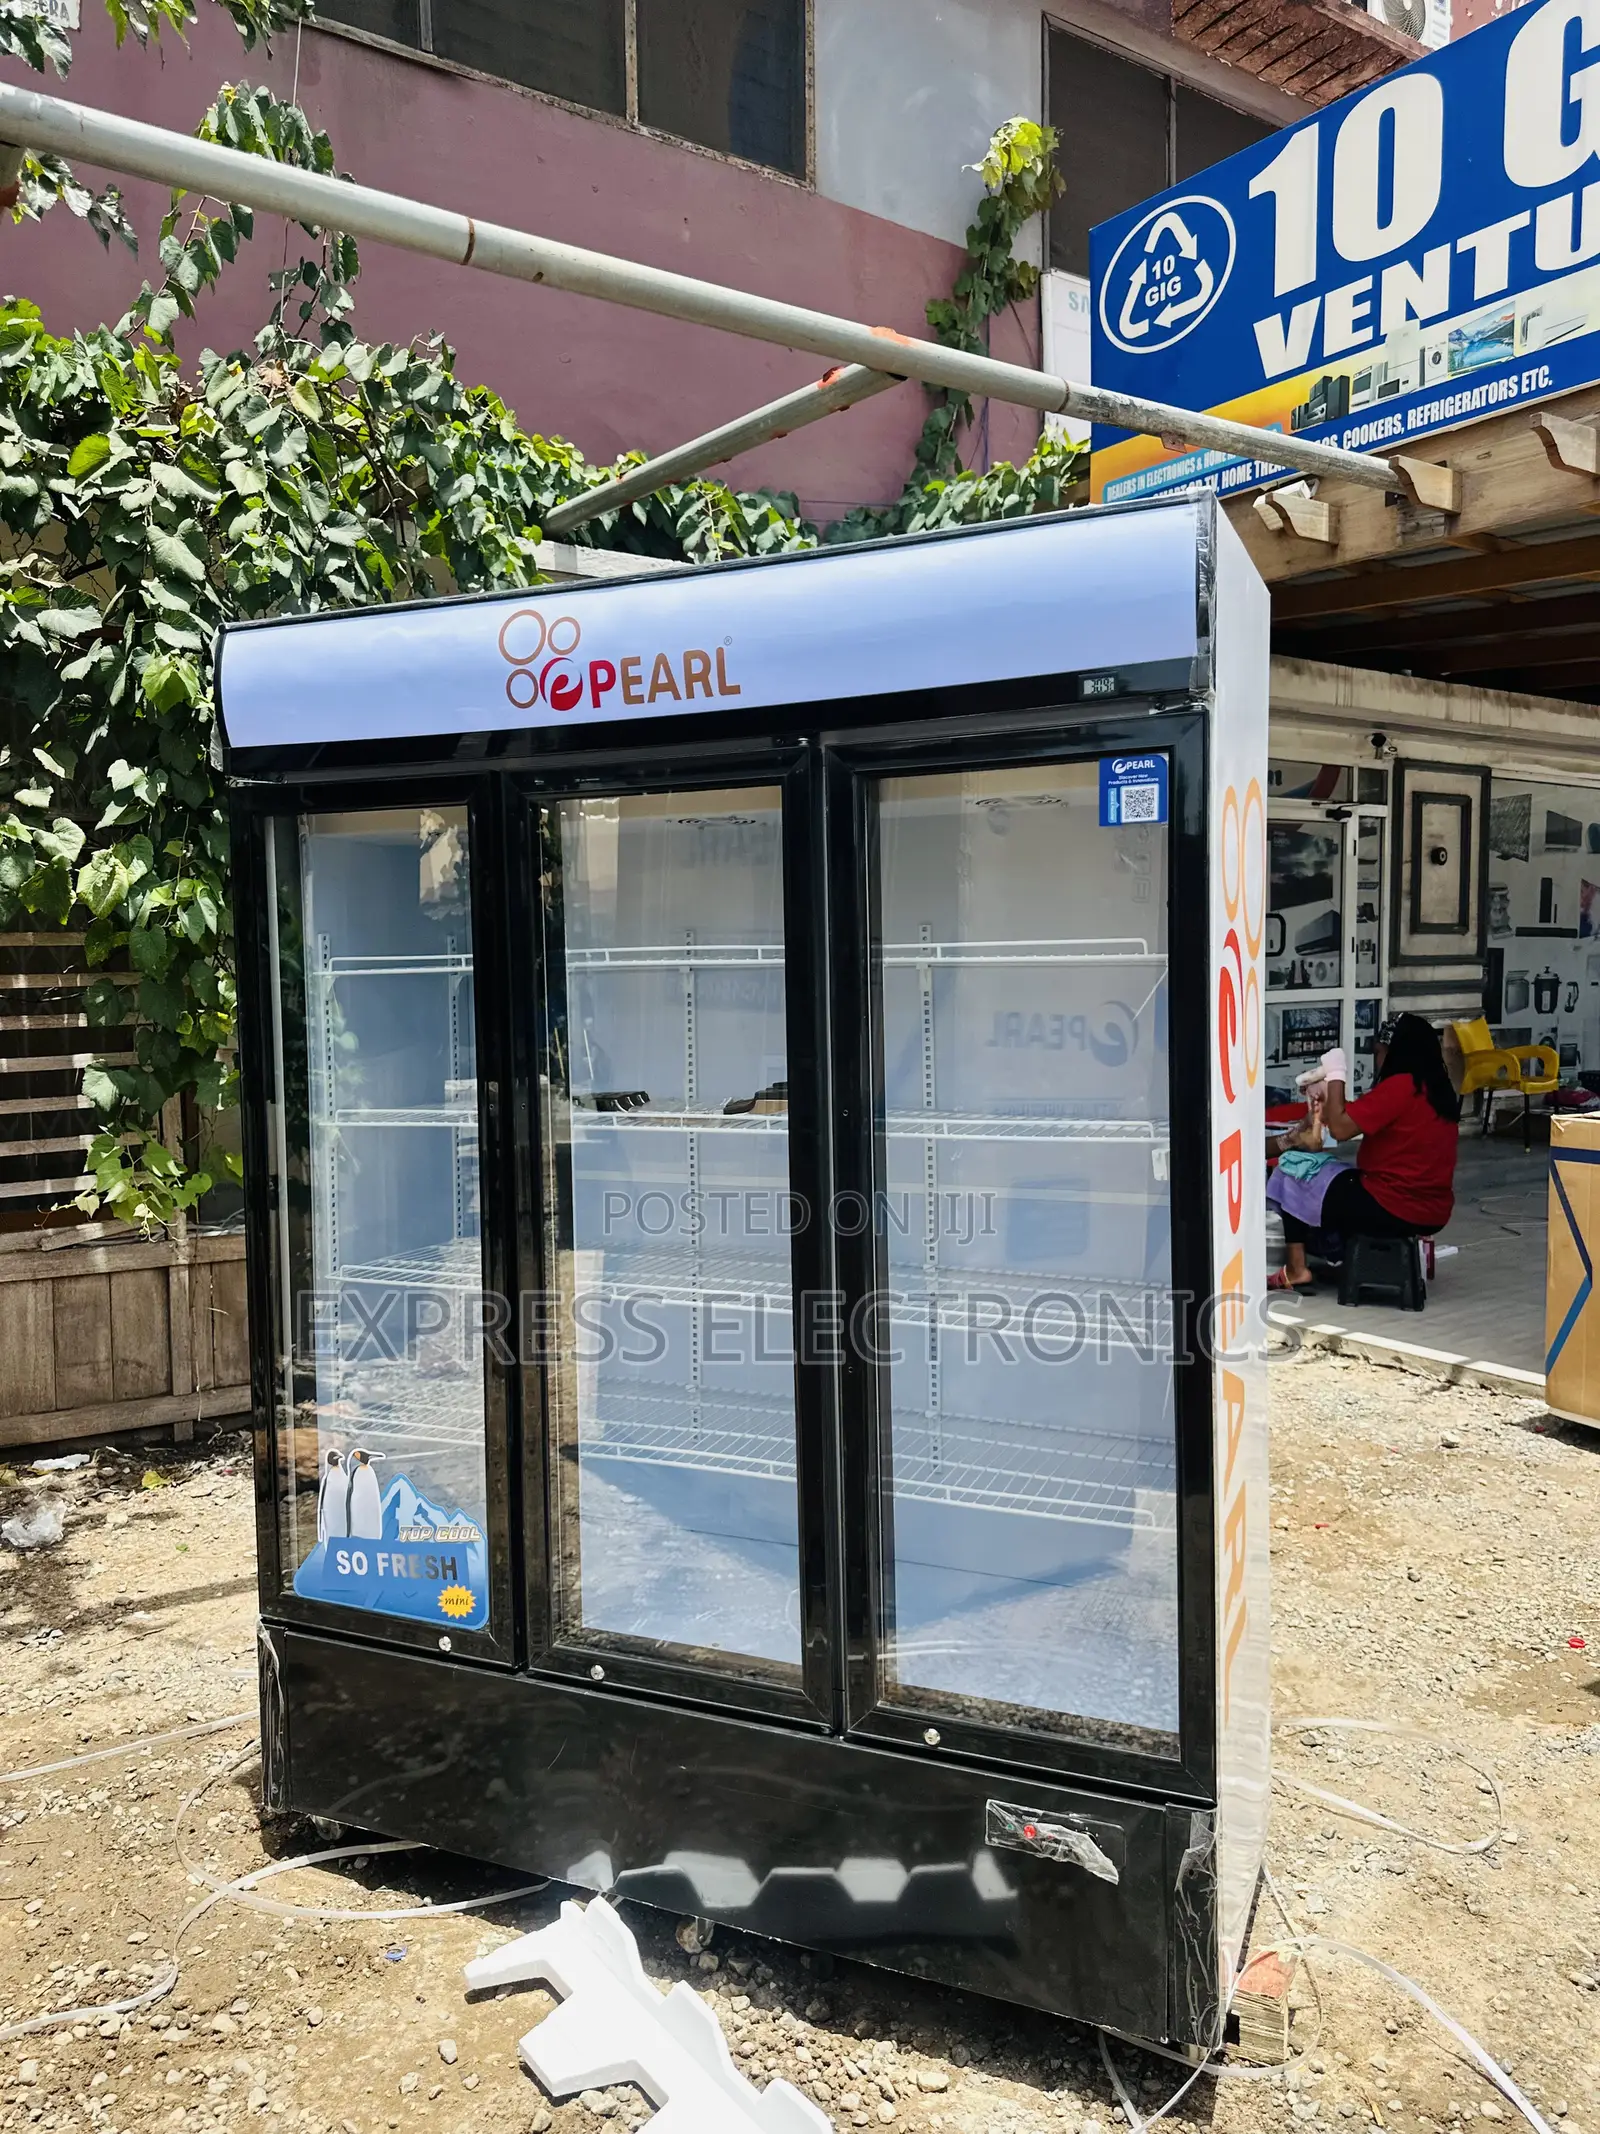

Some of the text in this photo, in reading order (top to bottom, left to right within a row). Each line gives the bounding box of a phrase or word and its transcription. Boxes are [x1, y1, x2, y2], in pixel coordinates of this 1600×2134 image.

[1248, 73, 1444, 298] 10
[1152, 254, 1176, 282] 10
[1144, 276, 1182, 308] GIG
[1221, 461, 1253, 489] HOME
[1343, 411, 1405, 450] COOKERS,
[1407, 378, 1518, 431] REFRIGERATORS
[1521, 364, 1553, 395] ETC.
[1106, 476, 1137, 502] DEALERS
[1137, 474, 1146, 489] IN
[1146, 456, 1196, 486] ELECTRONICS
[1196, 456, 1202, 471] &
[589, 646, 741, 709] PEARL
[1126, 759, 1156, 770] PEARL
[399, 1525, 482, 1543] TOP COOL
[336, 1550, 458, 1581] SO FRESH
[444, 1595, 470, 1607] mini
